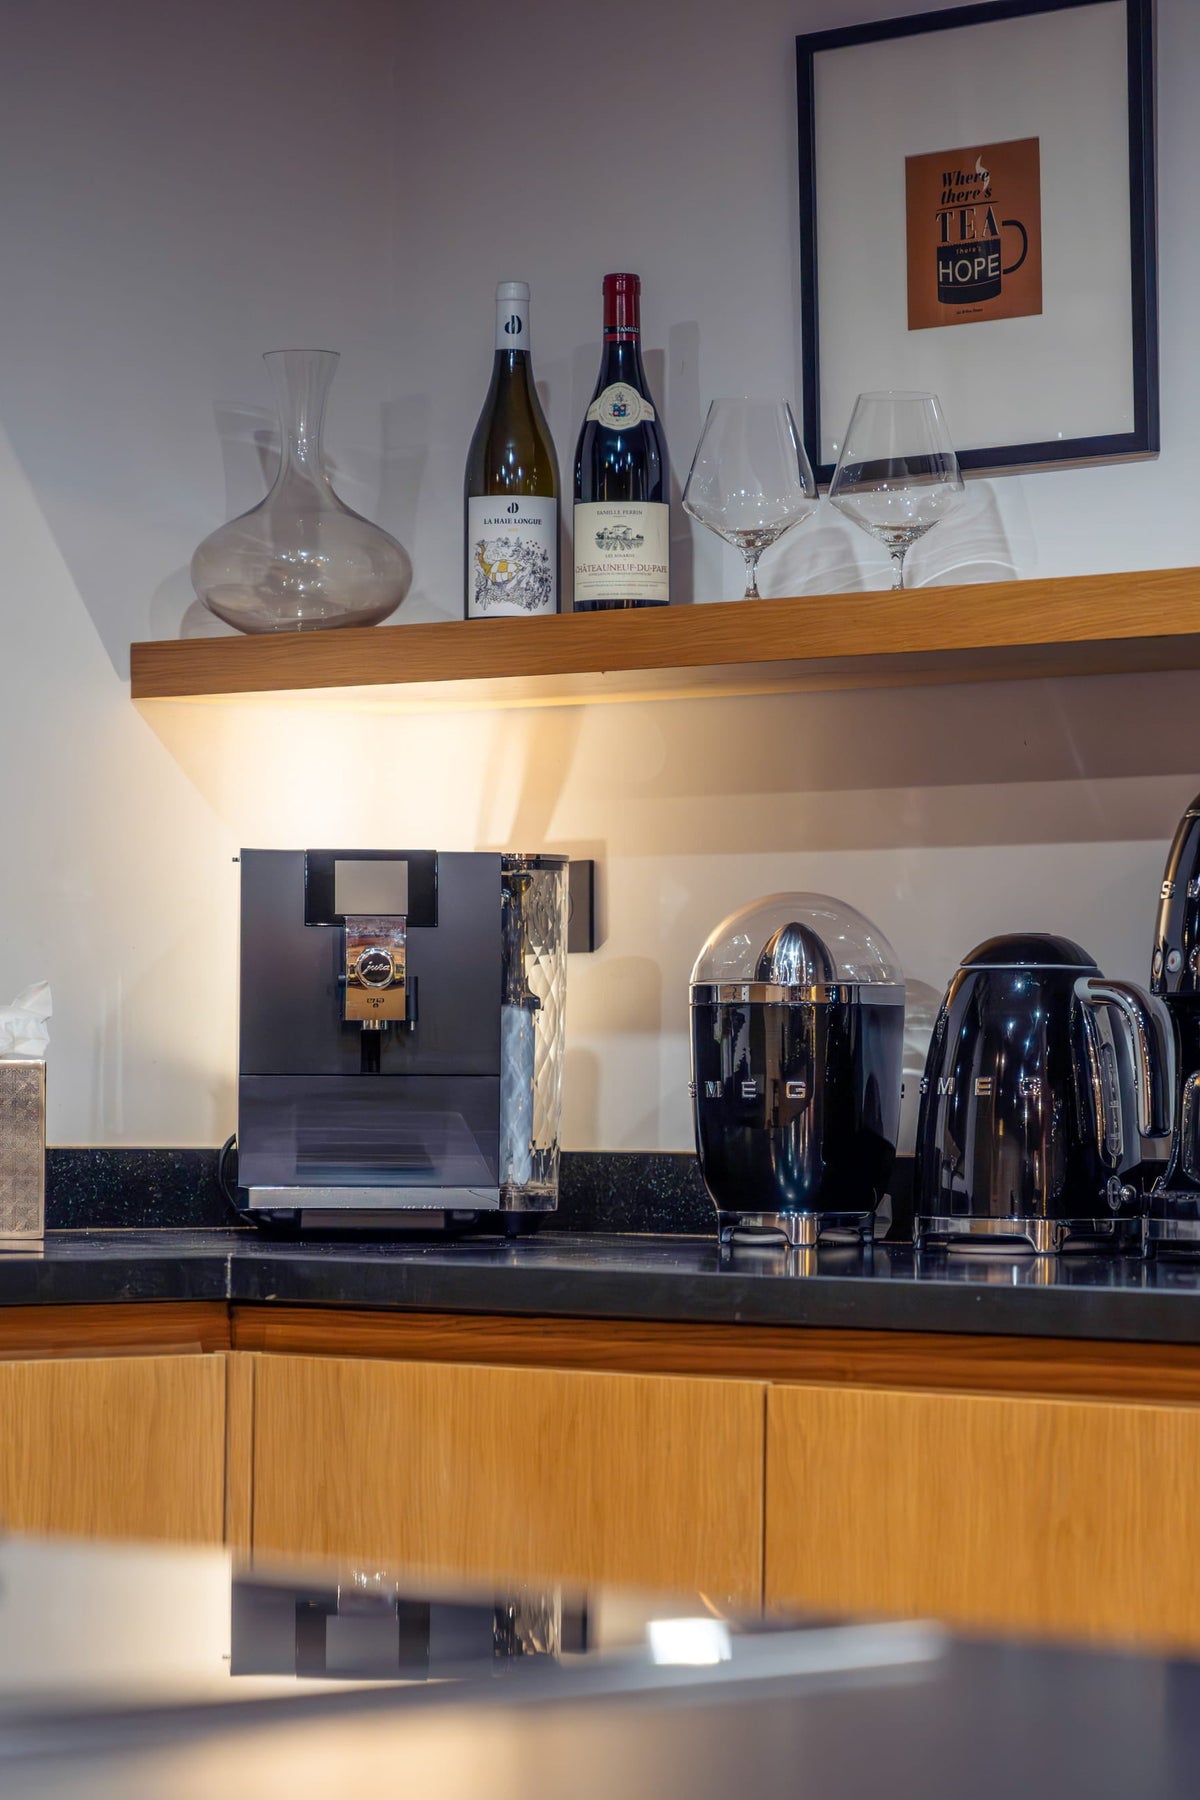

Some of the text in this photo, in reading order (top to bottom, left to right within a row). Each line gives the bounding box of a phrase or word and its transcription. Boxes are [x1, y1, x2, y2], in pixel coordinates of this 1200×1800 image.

[942, 170, 989, 188] Where
[936, 205, 1000, 242] TEA
[939, 253, 1000, 283] HOPE
[514, 518, 542, 526] LONGUE
[361, 961, 391, 975] jura
